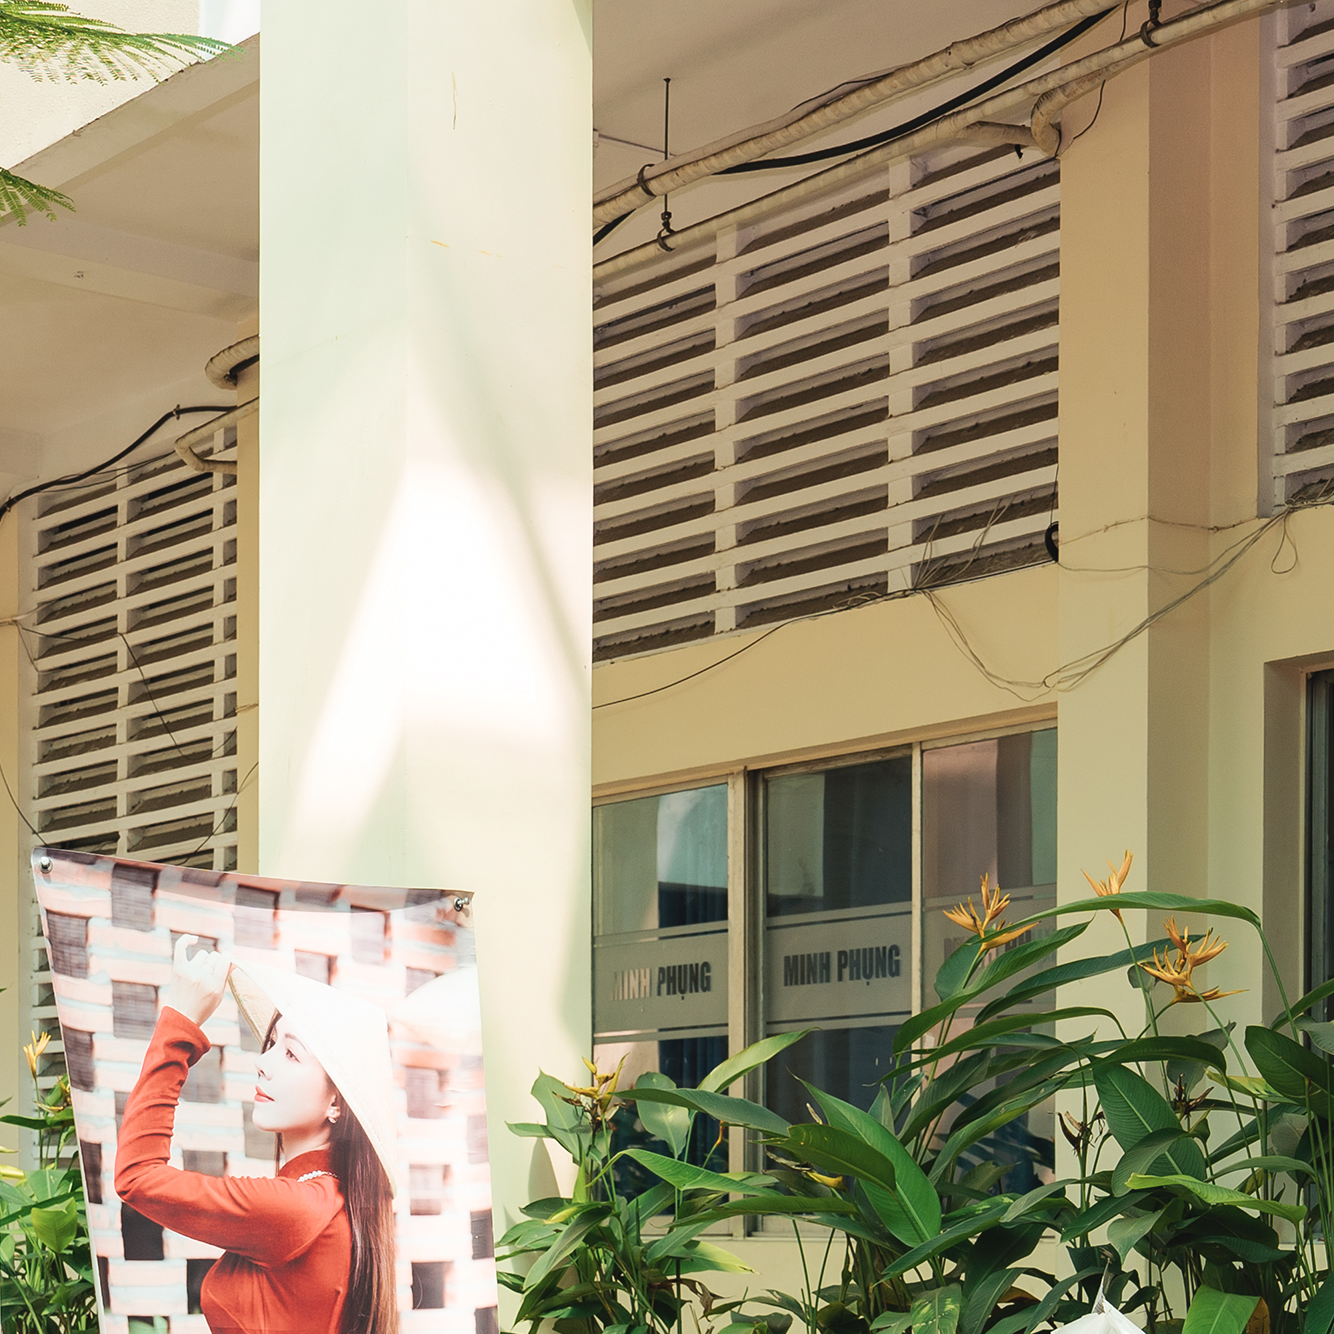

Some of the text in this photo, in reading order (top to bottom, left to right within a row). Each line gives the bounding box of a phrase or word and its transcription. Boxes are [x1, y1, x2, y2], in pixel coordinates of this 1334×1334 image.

[657, 961, 712, 1000] PHỤNG
[783, 950, 831, 987] MINH
[837, 944, 901, 986] PHỤNG
